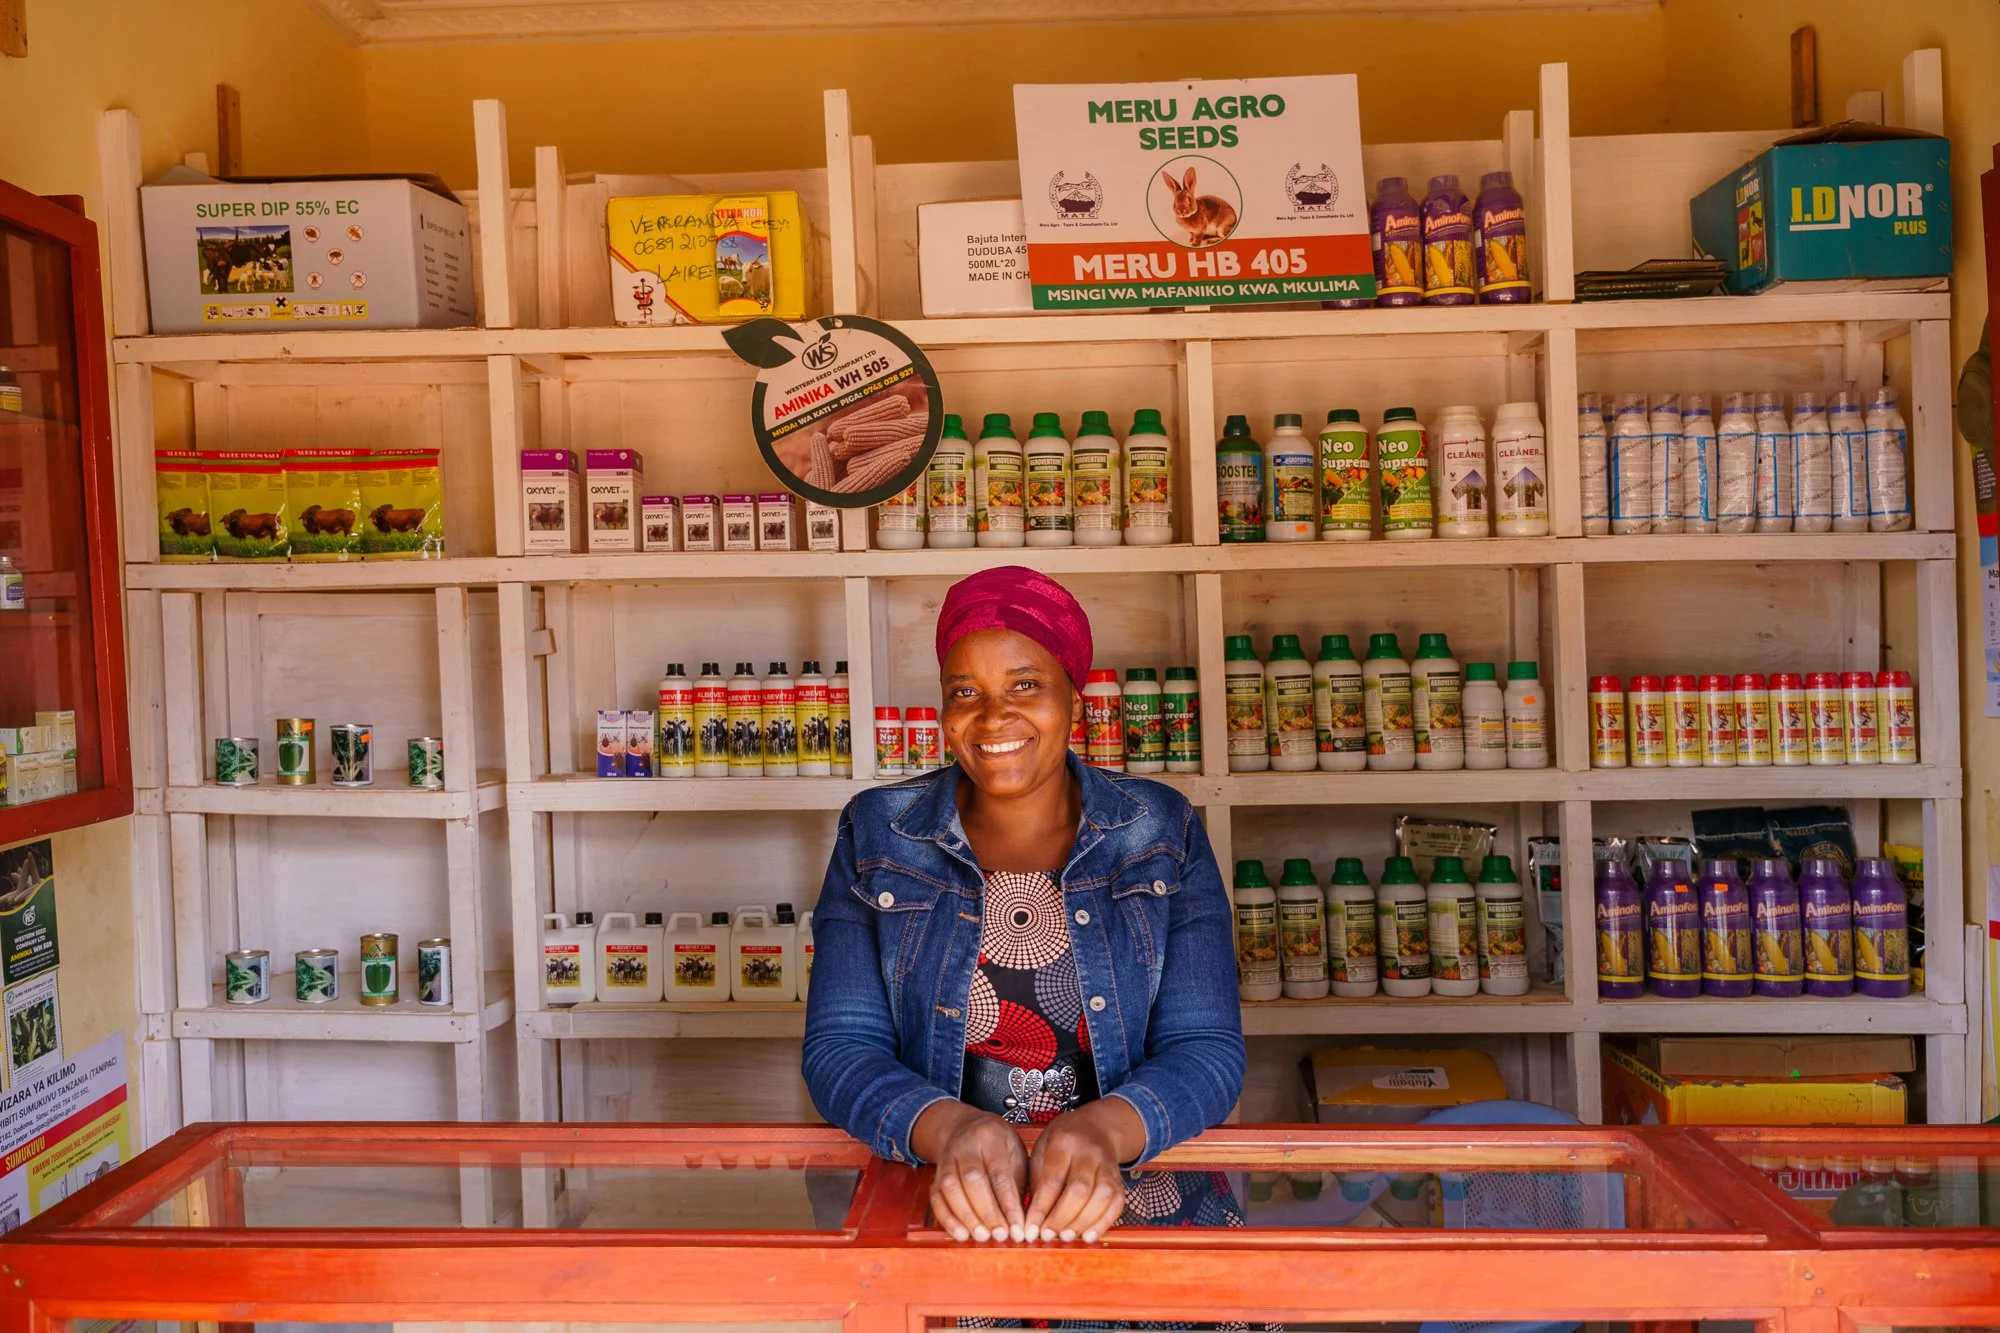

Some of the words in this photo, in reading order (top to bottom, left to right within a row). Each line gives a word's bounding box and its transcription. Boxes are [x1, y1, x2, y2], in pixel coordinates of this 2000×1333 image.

[1088, 99, 1177, 124] MERU
[1192, 94, 1285, 121] AGRO
[1139, 125, 1239, 151] SEEDS
[196, 203, 256, 218] SUPER
[262, 202, 289, 217] DIP
[295, 201, 330, 216] 55%
[336, 200, 360, 215] EC
[1894, 220, 1927, 235] PLUS
[967, 235, 998, 245] Bajuta
[967, 247, 1012, 256] DUDUBA
[1015, 246, 1027, 254] 45
[1073, 252, 1177, 281] MERU
[1188, 250, 1240, 278] HB
[1250, 249, 1307, 275] 405
[968, 272, 999, 281] MADE
[1002, 272, 1012, 280] IN
[1048, 287, 1106, 302] MSINGI
[1108, 286, 1138, 300] WA
[1142, 284, 1234, 299] MAFANIKIO
[1239, 282, 1279, 297] KWA
[1283, 279, 1360, 294] MKULIMA
[785, 378, 815, 395] WESTERN
[816, 371, 832, 382] SEED
[833, 355, 864, 374] COMPANY
[864, 349, 877, 359] LTD
[774, 383, 836, 420] AMINIKA
[834, 369, 862, 390] WH
[863, 356, 890, 377] 505
[772, 422, 798, 438] MUDA:
[798, 416, 813, 425] WA
[812, 406, 832, 418] KATI
[840, 392, 863, 406] PIGA:
[863, 382, 883, 395] 0745
[884, 375, 899, 385] 028
[900, 367, 914, 378] 927
[1321, 439, 1354, 455] Neo
[1378, 440, 1409, 455] Neo
[1499, 447, 1540, 458] CLEANER
[526, 487, 556, 495] OXYVET
[591, 486, 620, 494] OXYVET
[1085, 708, 1111, 718] Neo
[1125, 701, 1149, 711] Neo
[880, 733, 897, 741] Neo
[916, 733, 933, 741] Neo
[33, 1080, 45, 1094] YA
[46, 1062, 76, 1087] KILIMO
[19, 1091, 57, 1118] SUMUKUVU
[57, 1073, 88, 1097] TANZANIA
[89, 1056, 118, 1080] (TANIPAC)
[13, 1119, 34, 1135] Dodoma,
[0, 1141, 15, 1152] Barua
[5, 1135, 45, 1171] SUMUKUVU
